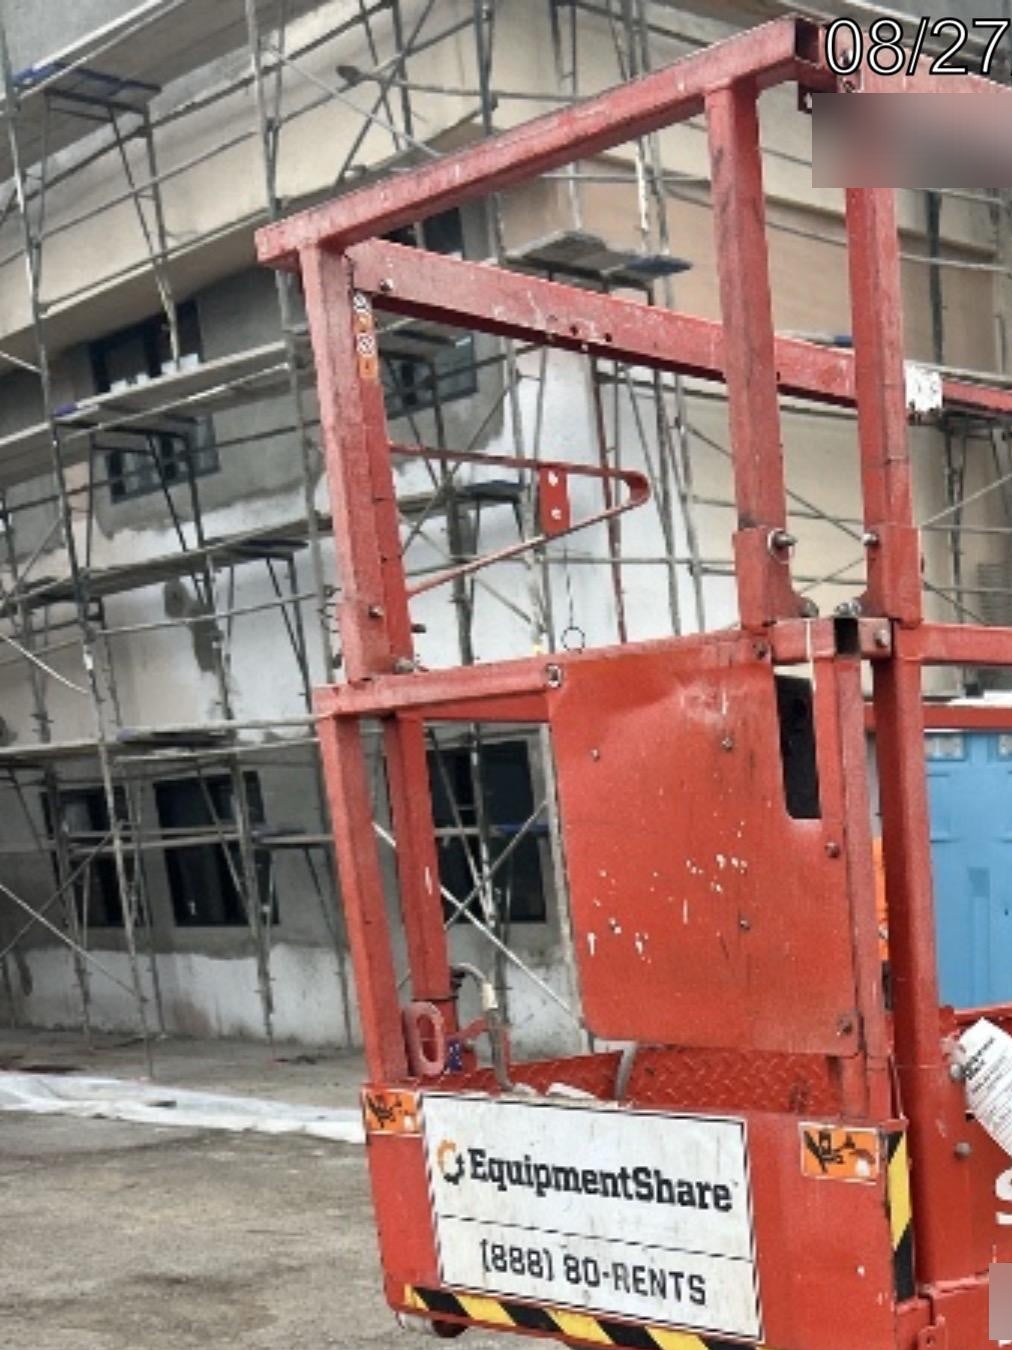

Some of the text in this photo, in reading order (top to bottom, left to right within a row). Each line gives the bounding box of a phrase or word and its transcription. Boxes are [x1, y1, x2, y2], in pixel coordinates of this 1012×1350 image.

[467, 1148, 733, 1213] EquipmentShare
[480, 1237, 707, 1306] (888) 80-RENTS
